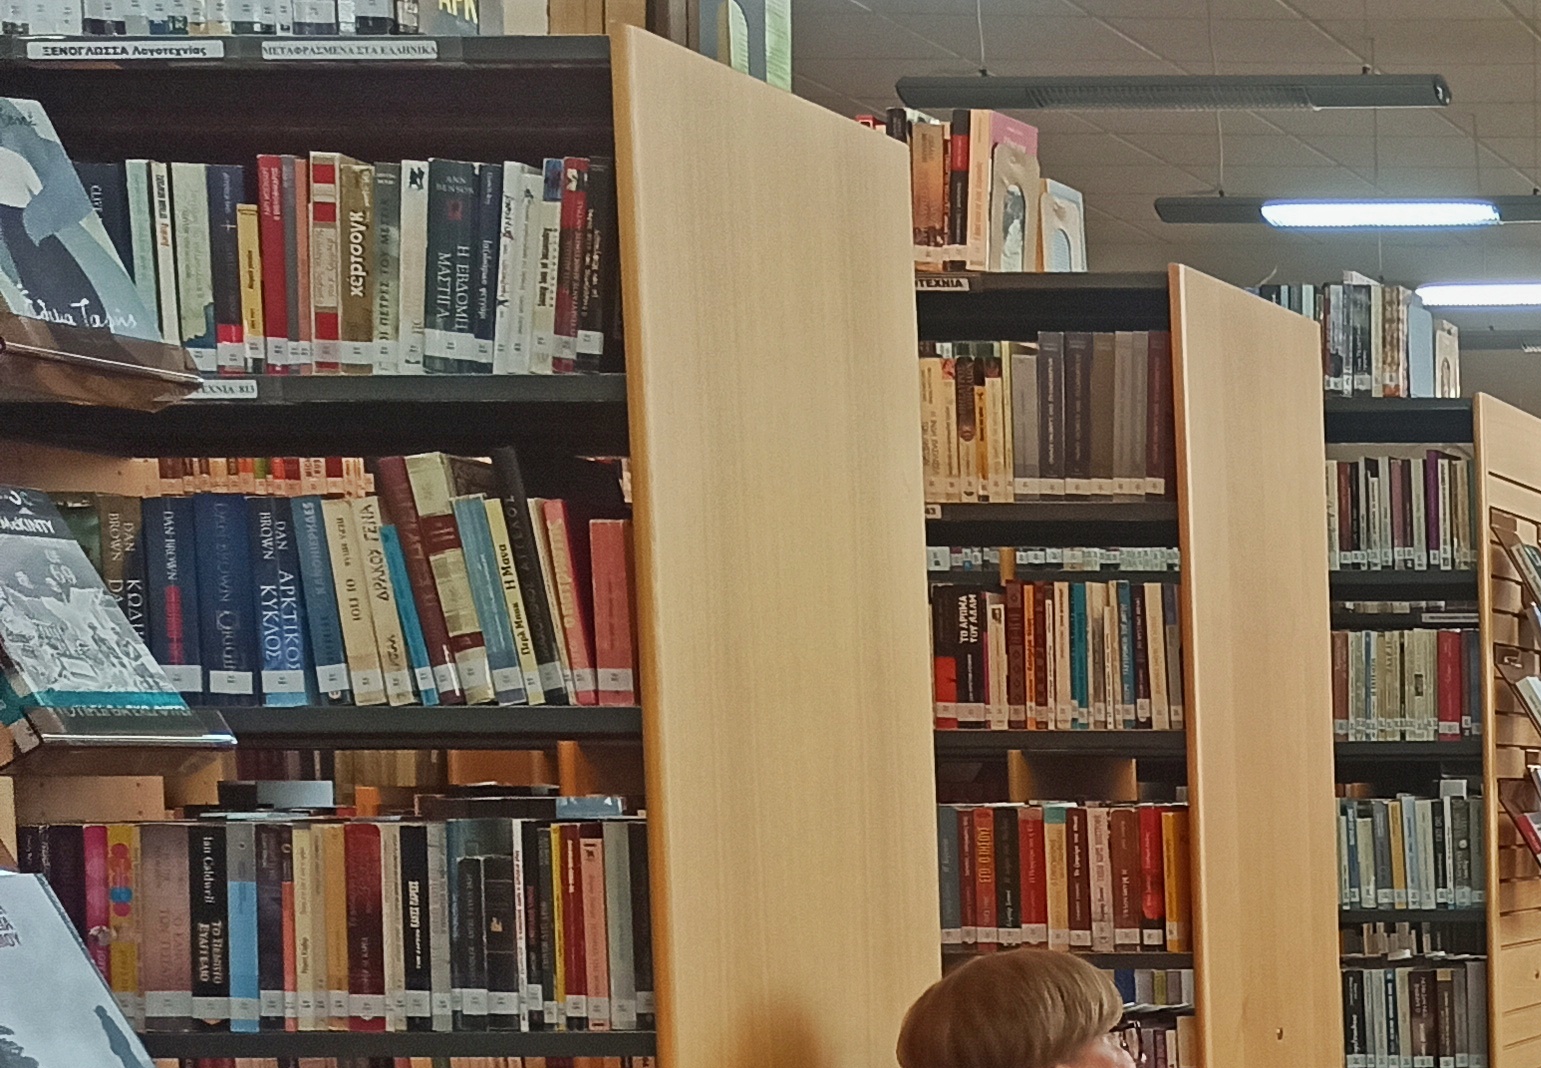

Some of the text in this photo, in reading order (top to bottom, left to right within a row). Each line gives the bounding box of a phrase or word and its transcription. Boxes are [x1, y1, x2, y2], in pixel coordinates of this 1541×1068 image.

[43, 45, 129, 57] ΞΕΝΟΓΛΩΣΣΑ
[263, 45, 438, 56] ΜΕΤΑΦΡΑΣΜΕΝΑ ΣΤΑ ΕΛΛΗΝΙΚΑ
[435, 251, 449, 319] ΜΑΣΤΙΓΑ
[454, 262, 469, 333] ΕΒΔΟΜΗ
[915, 278, 963, 288] ΤΕΧΝΙΑ
[107, 512, 121, 562] BROWN
[123, 521, 135, 553] DAN
[259, 511, 274, 561] BROWN
[276, 520, 288, 551] DAN
[367, 548, 390, 602] ΔΡΑΚΟΥ
[260, 584, 281, 662] ΚΥΚΛΟΣ
[202, 835, 215, 904] Ian Caldwell
